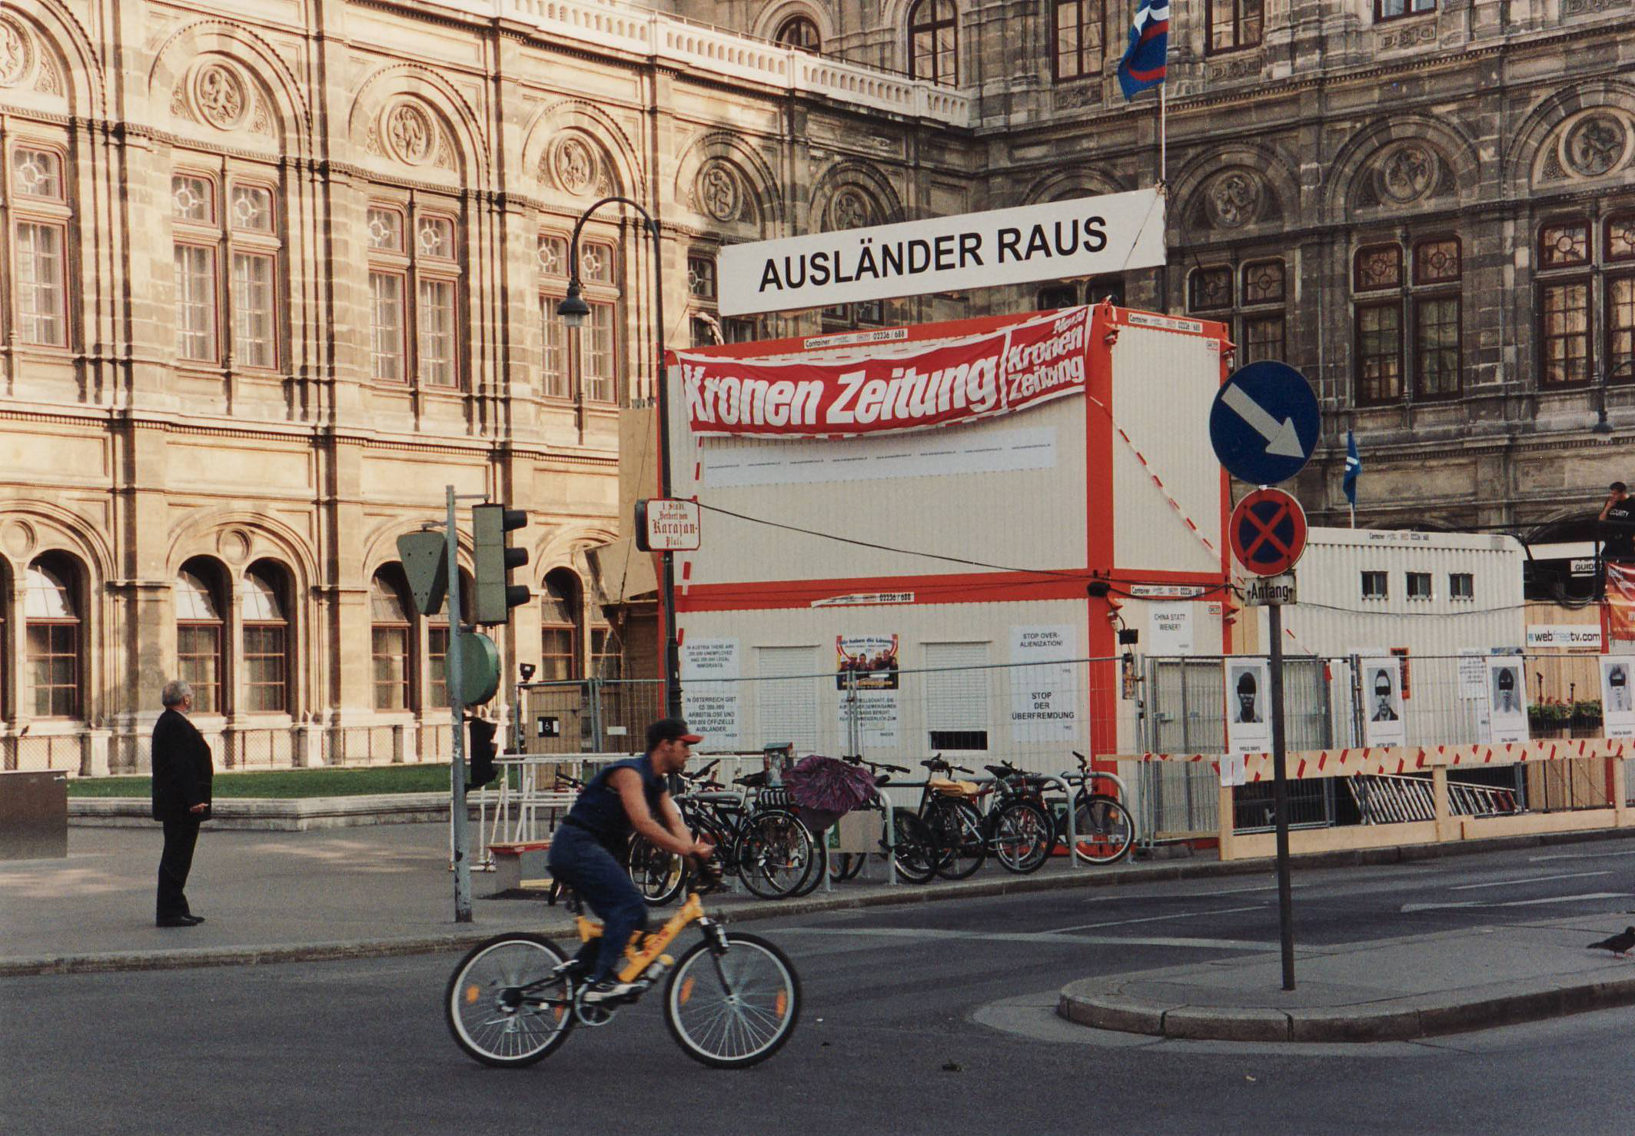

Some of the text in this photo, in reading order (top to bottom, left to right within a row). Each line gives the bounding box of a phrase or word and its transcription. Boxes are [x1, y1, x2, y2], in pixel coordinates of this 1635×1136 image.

[759, 217, 1107, 292] AUSLÄNDER RAUS
[805, 339, 831, 348] Container
[1007, 325, 1083, 373] Kronen
[1008, 355, 1085, 401] Zeitung
[683, 355, 998, 426] Kronen Zeitung
[652, 519, 698, 537] Karajan-
[1574, 562, 1594, 571] GUID
[1251, 582, 1289, 602] Anfang
[1154, 613, 1186, 621] CHINA STATT
[1534, 630, 1600, 642] webfreetv.com
[1031, 692, 1052, 700] STOP
[1033, 702, 1050, 710] DER
[1012, 711, 1075, 720] ÜBERFREMDUNG
